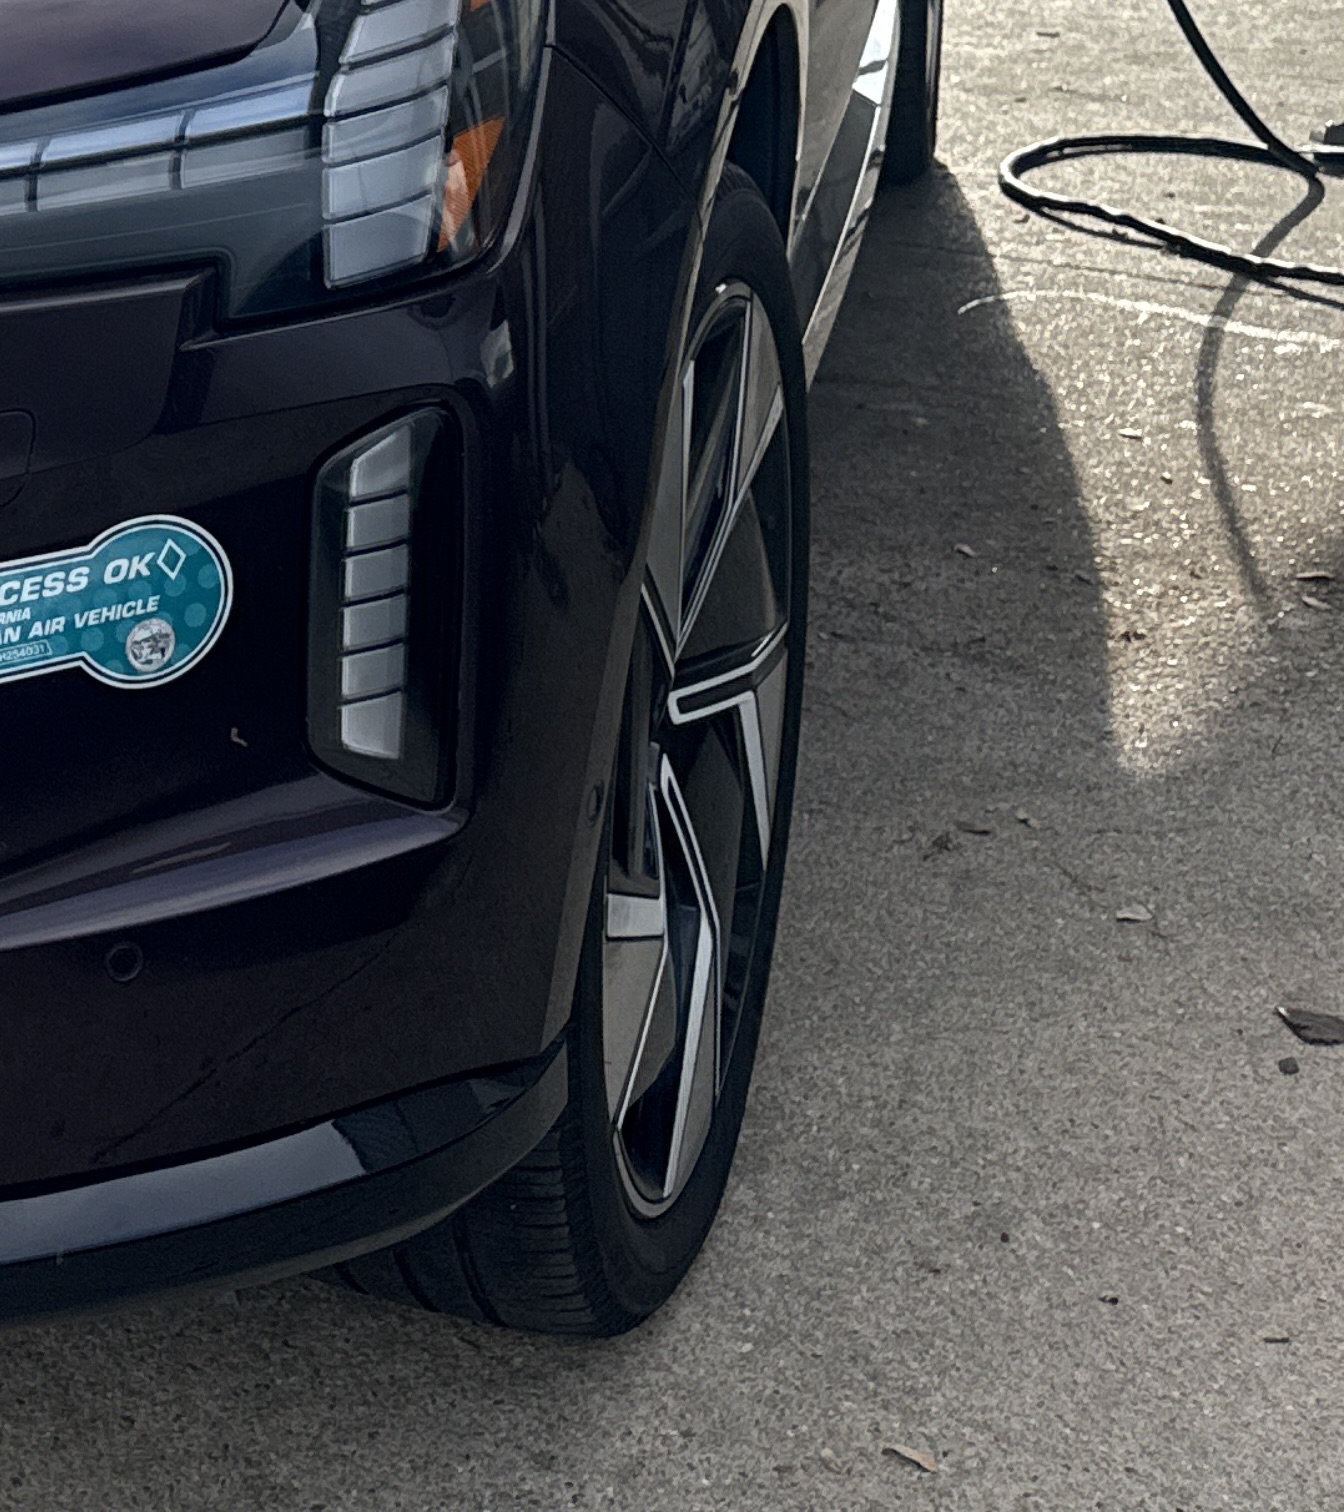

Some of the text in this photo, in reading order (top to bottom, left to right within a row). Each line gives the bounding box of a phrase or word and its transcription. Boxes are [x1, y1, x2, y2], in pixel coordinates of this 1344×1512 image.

[103, 551, 156, 586] OK
[28, 616, 66, 640] AIR
[74, 595, 161, 630] VEHICLE
